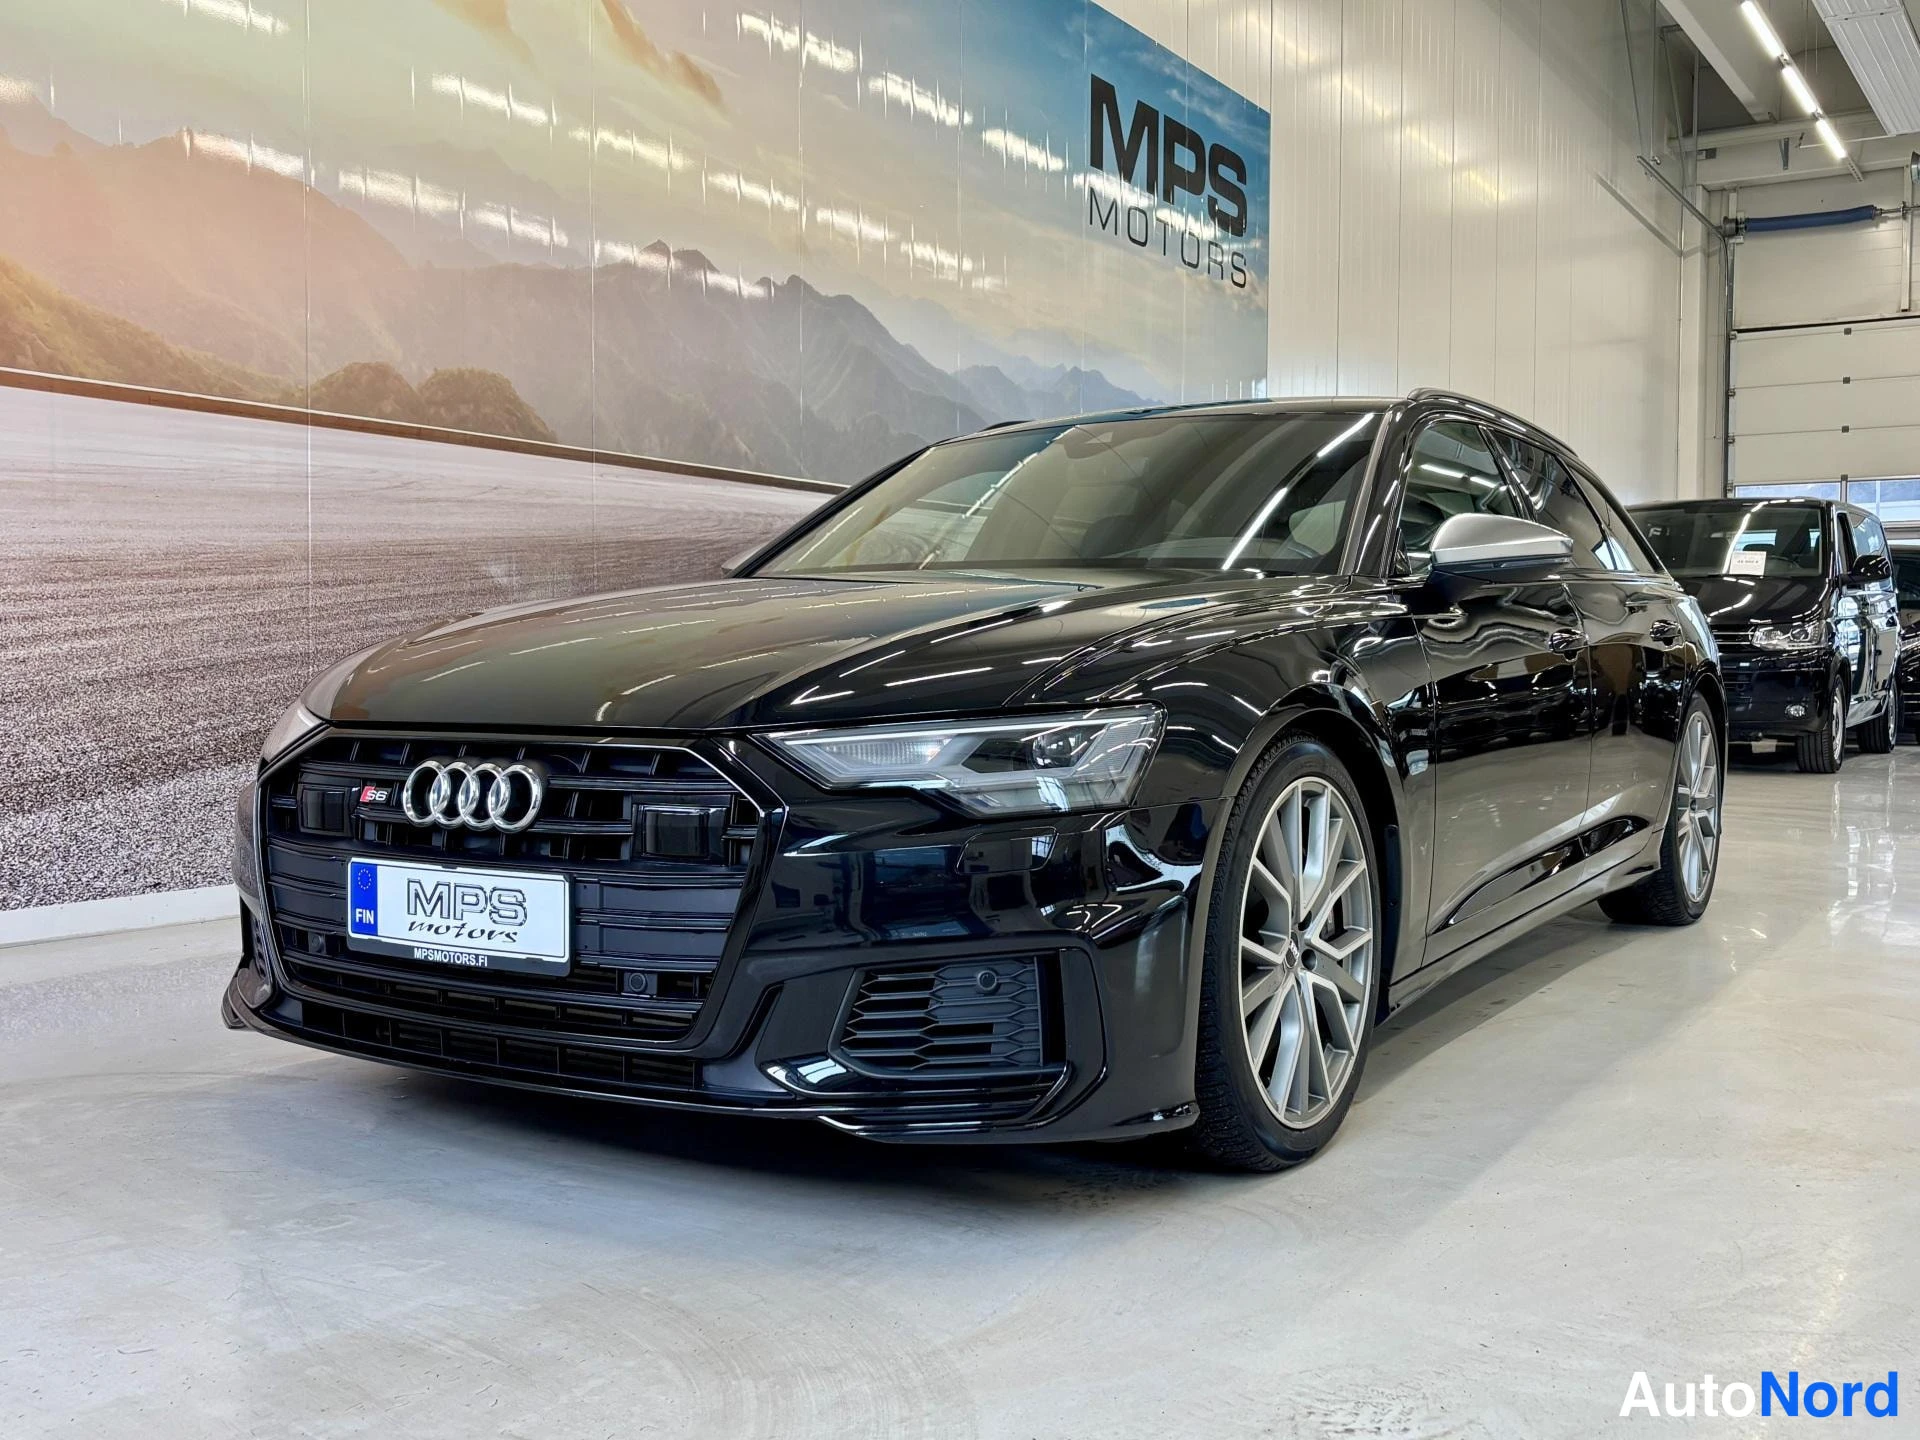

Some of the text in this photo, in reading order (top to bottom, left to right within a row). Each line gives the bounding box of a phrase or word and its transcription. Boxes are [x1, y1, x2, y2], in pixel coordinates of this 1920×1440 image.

[1090, 73, 1247, 237] MPS
[1089, 187, 1246, 288] MOTORS
[355, 908, 374, 924] FIN
[407, 878, 528, 927] MPS
[408, 921, 518, 943] motors
[414, 948, 488, 967] MPSMOTORS.FI
